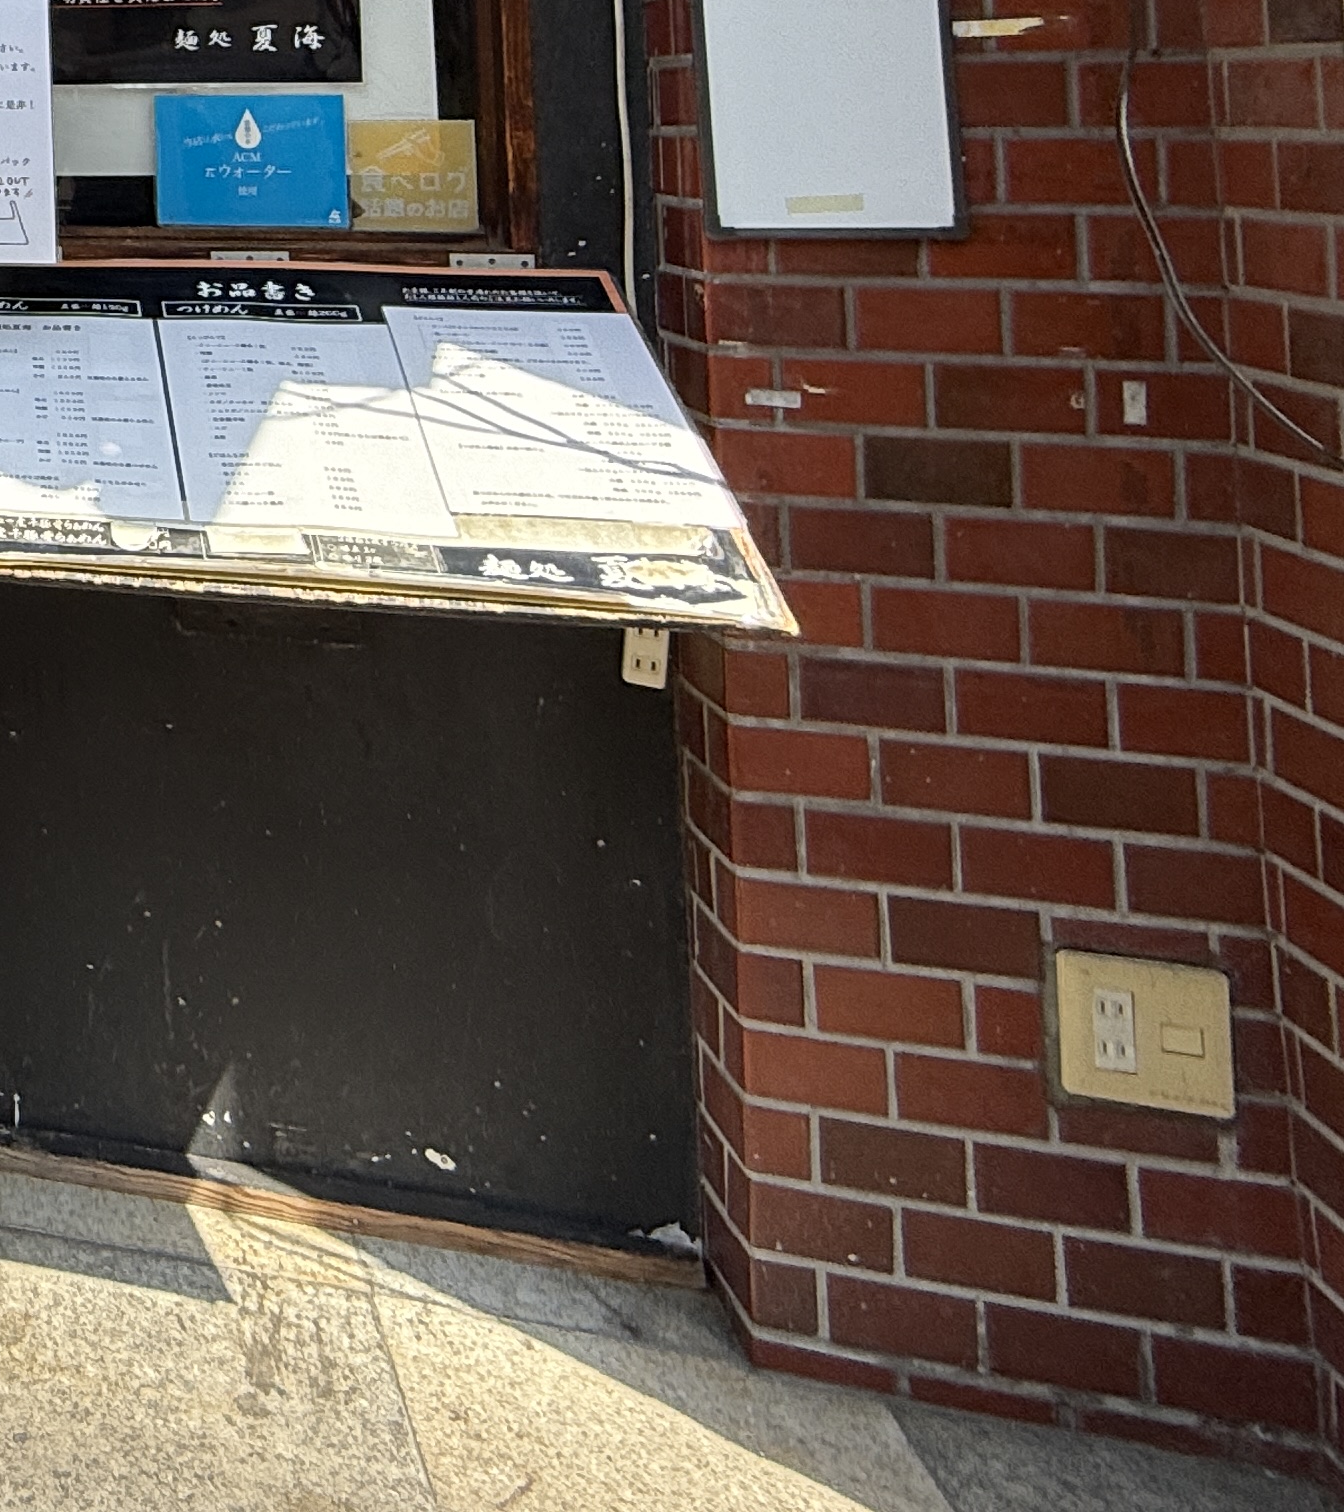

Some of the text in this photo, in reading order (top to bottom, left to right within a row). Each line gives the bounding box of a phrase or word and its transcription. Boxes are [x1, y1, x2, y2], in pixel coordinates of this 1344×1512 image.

[196, 280, 316, 302] お品書き
[177, 303, 248, 315] つけめん
